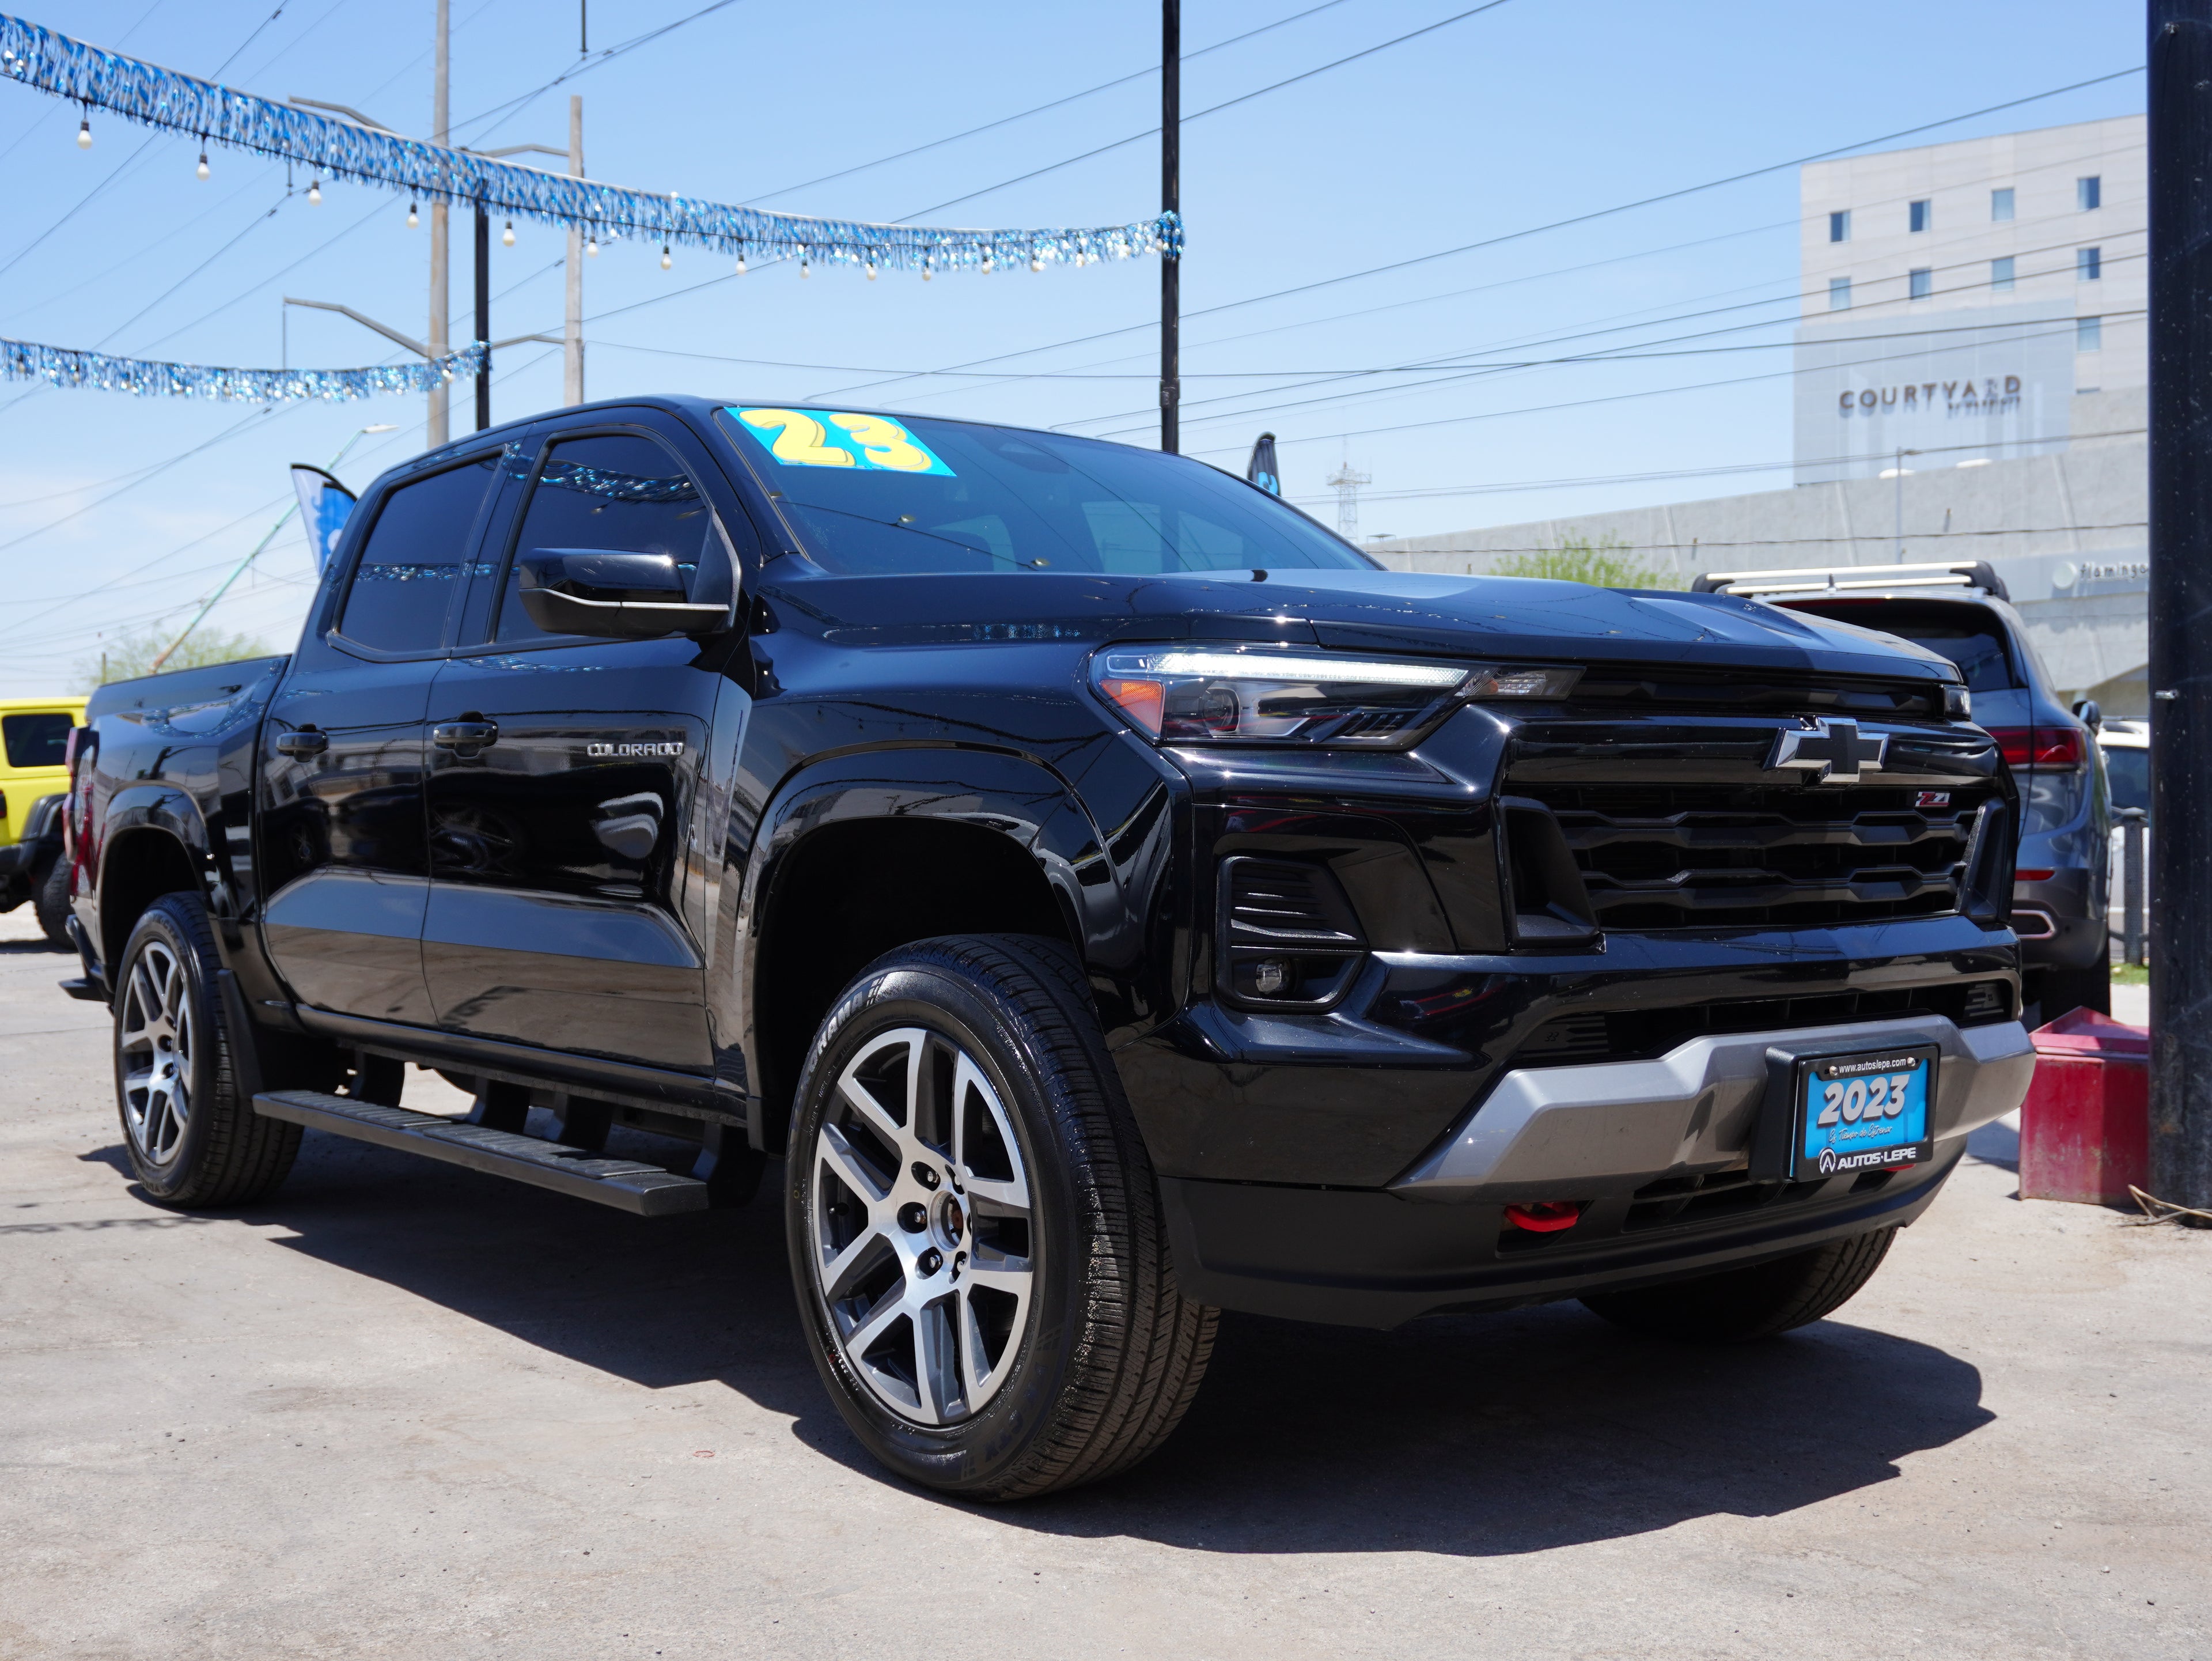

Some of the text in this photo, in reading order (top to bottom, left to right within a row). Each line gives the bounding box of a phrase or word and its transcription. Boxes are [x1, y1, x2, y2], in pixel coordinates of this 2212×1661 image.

[739, 409, 932, 471] 23
[587, 742, 684, 756] COLORADO
[1915, 792, 1950, 807] Z71
[1839, 1058, 1906, 1073] www.autoslepe.com
[1818, 1074, 1910, 1124] 2023
[1859, 1127, 1867, 1137] de
